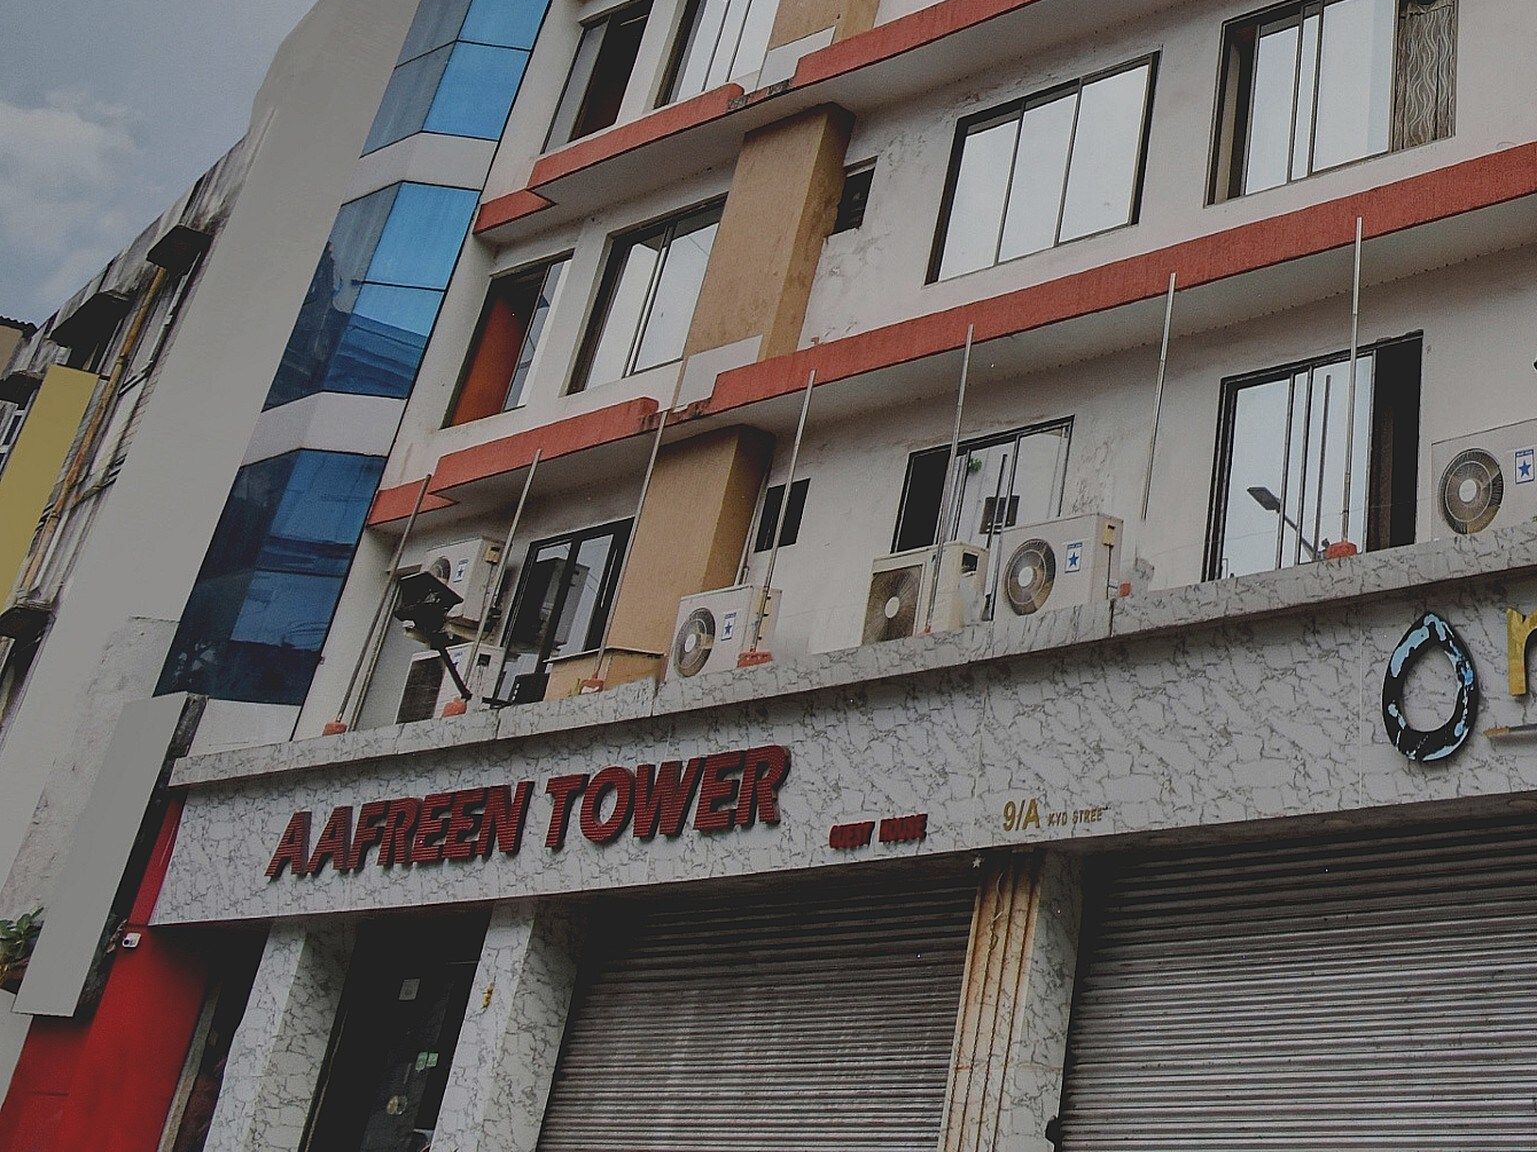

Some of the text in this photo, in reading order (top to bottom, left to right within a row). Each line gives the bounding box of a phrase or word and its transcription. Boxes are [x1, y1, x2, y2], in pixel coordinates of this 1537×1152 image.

[266, 745, 791, 878] AAFREEN TOWER
[1003, 798, 1041, 831] 9/A
